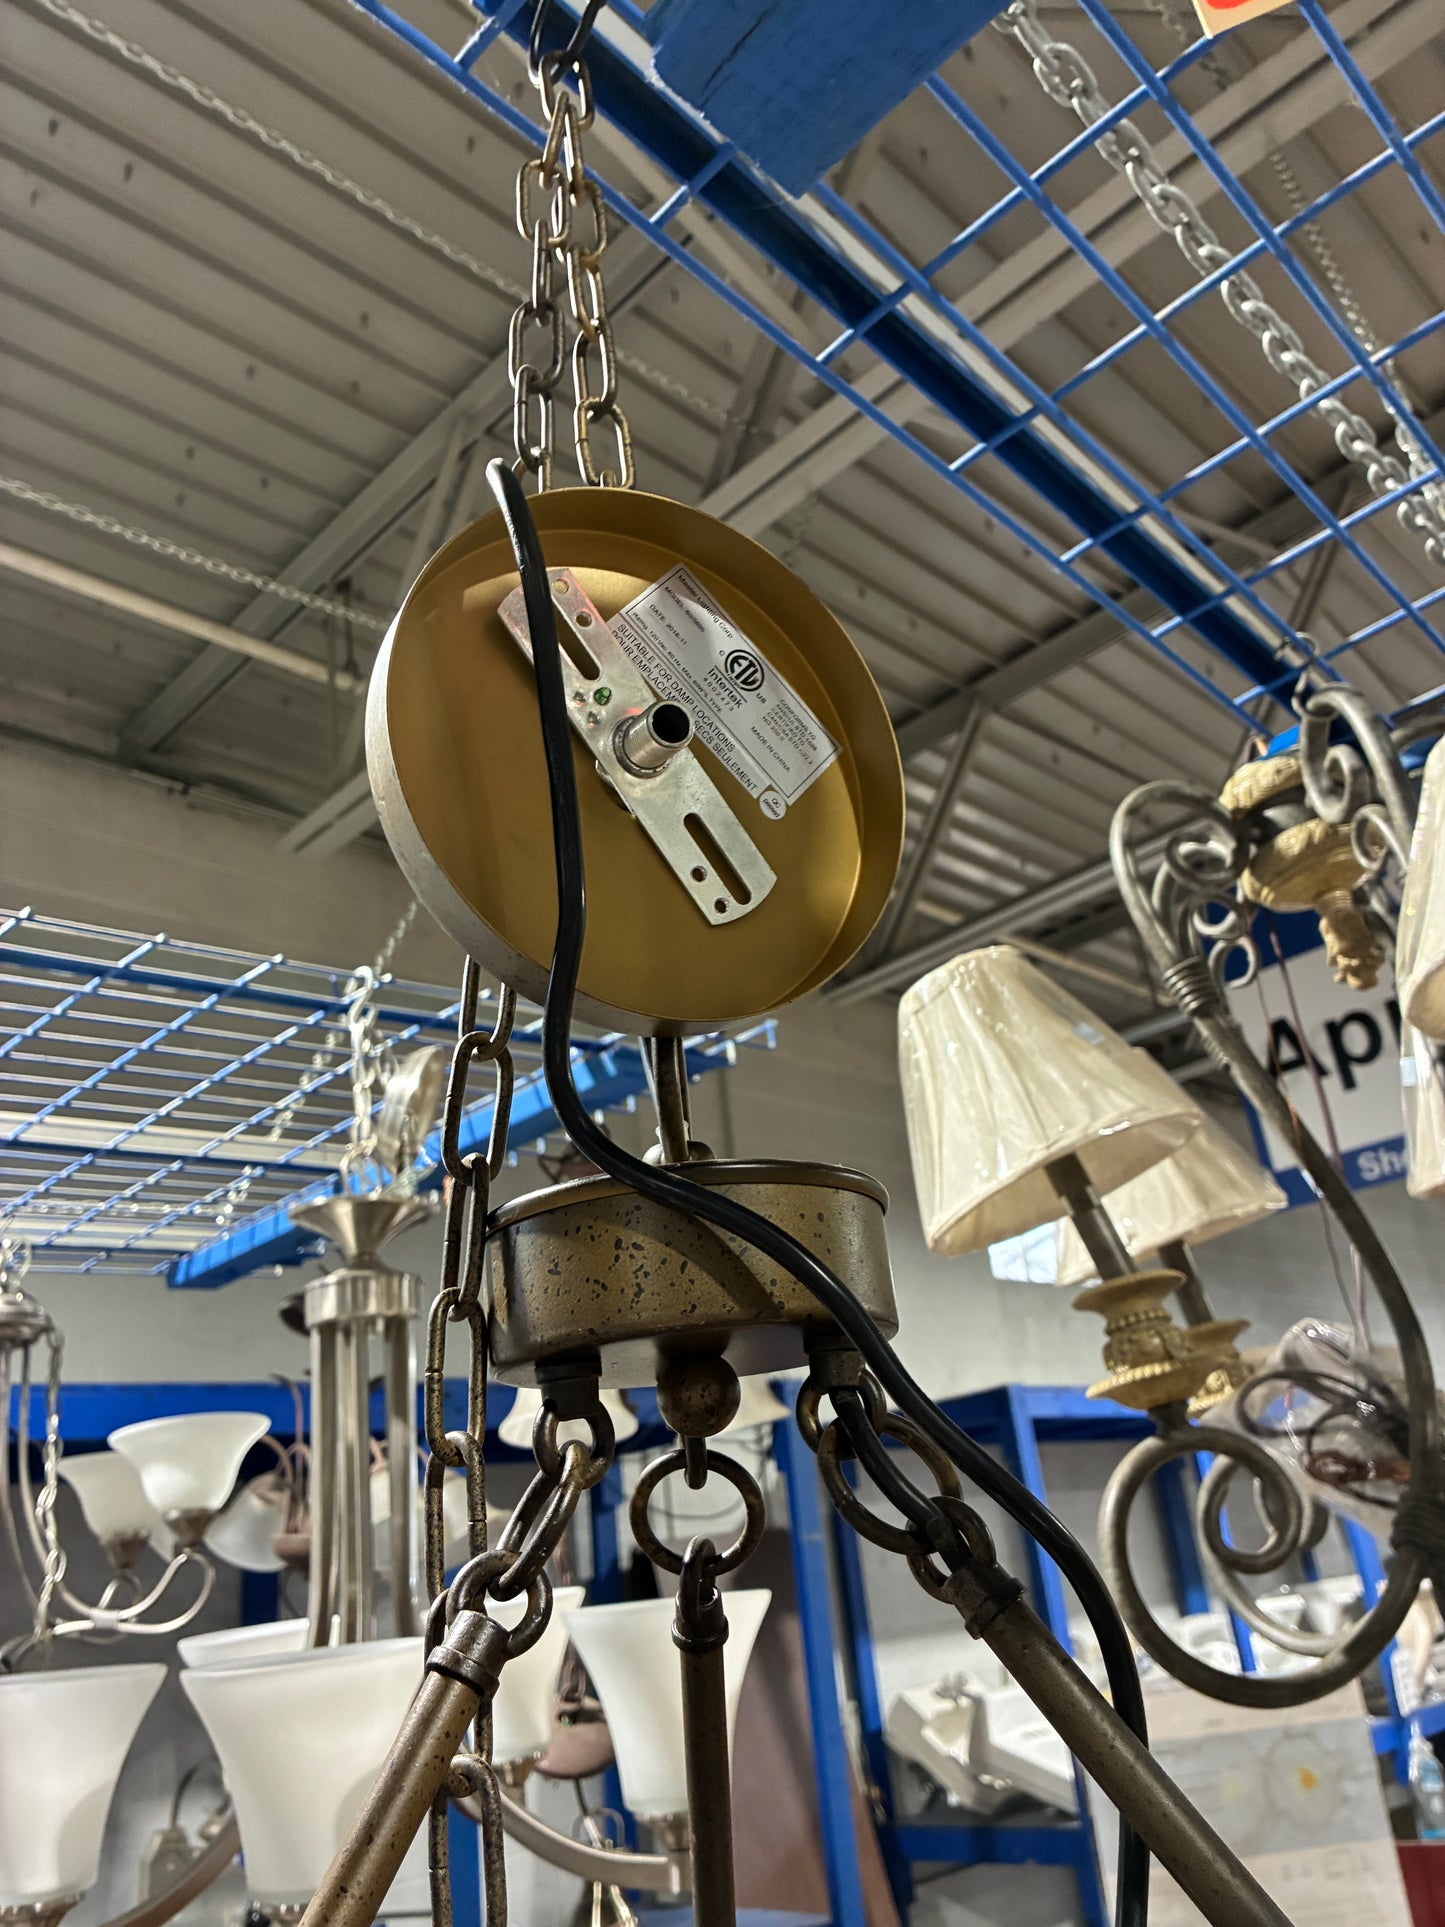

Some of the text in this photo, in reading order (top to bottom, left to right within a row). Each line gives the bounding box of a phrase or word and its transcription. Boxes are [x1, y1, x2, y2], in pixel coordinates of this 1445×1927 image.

[696, 596, 720, 622] Lighting
[617, 623, 655, 664] SUITABLE
[653, 662, 672, 682] FOR
[670, 680, 694, 707] DAMP
[692, 704, 735, 752] LOCATIONS
[707, 668, 743, 708] Intertek
[712, 742, 757, 792] SEULEMENT
[750, 726, 767, 745] MADE
[772, 751, 791, 772] CHINA
[1267, 998, 1403, 1091] Ap
